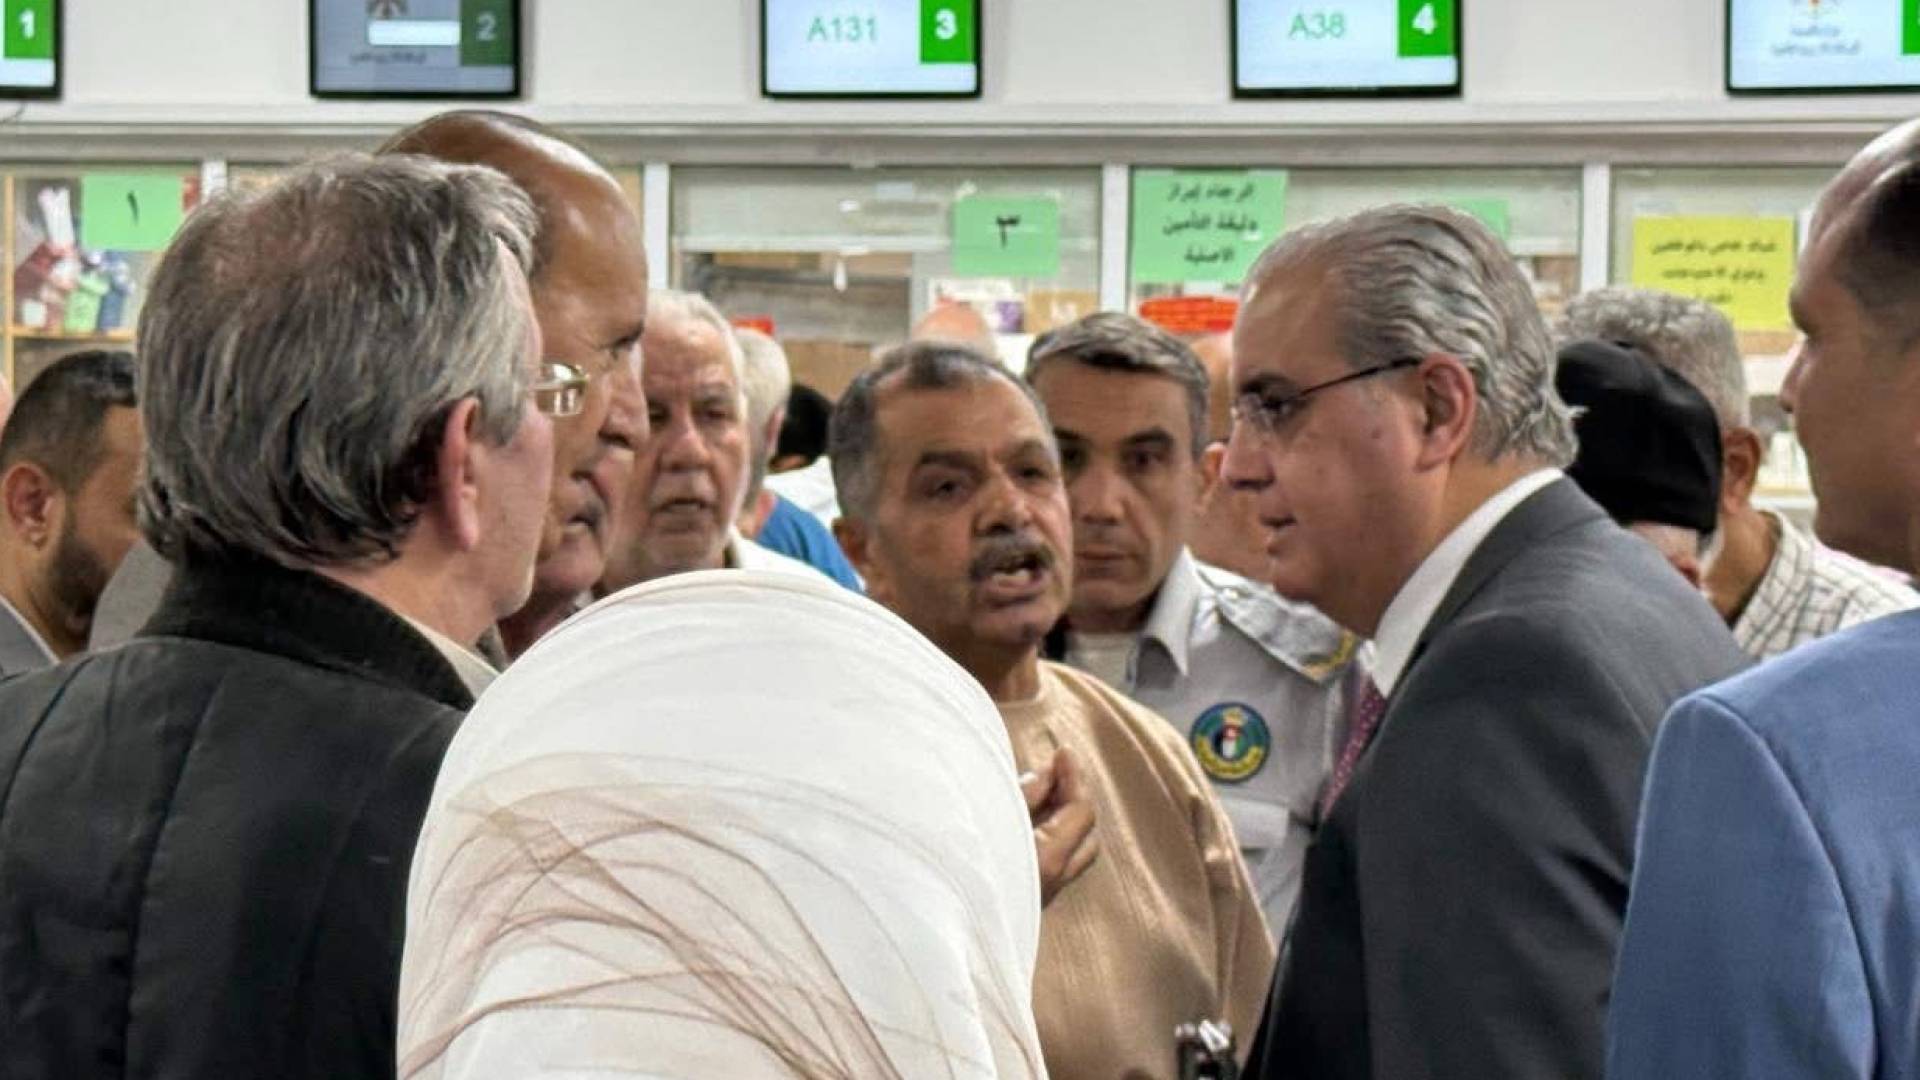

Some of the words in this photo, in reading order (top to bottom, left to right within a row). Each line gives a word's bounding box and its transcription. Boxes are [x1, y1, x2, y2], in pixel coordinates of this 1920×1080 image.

[19, 9, 36, 38] 1
[475, 12, 497, 41] 2
[807, 16, 878, 42] A131
[935, 8, 957, 40] 3
[1288, 13, 1346, 39] A38
[1411, 2, 1437, 35] 4
